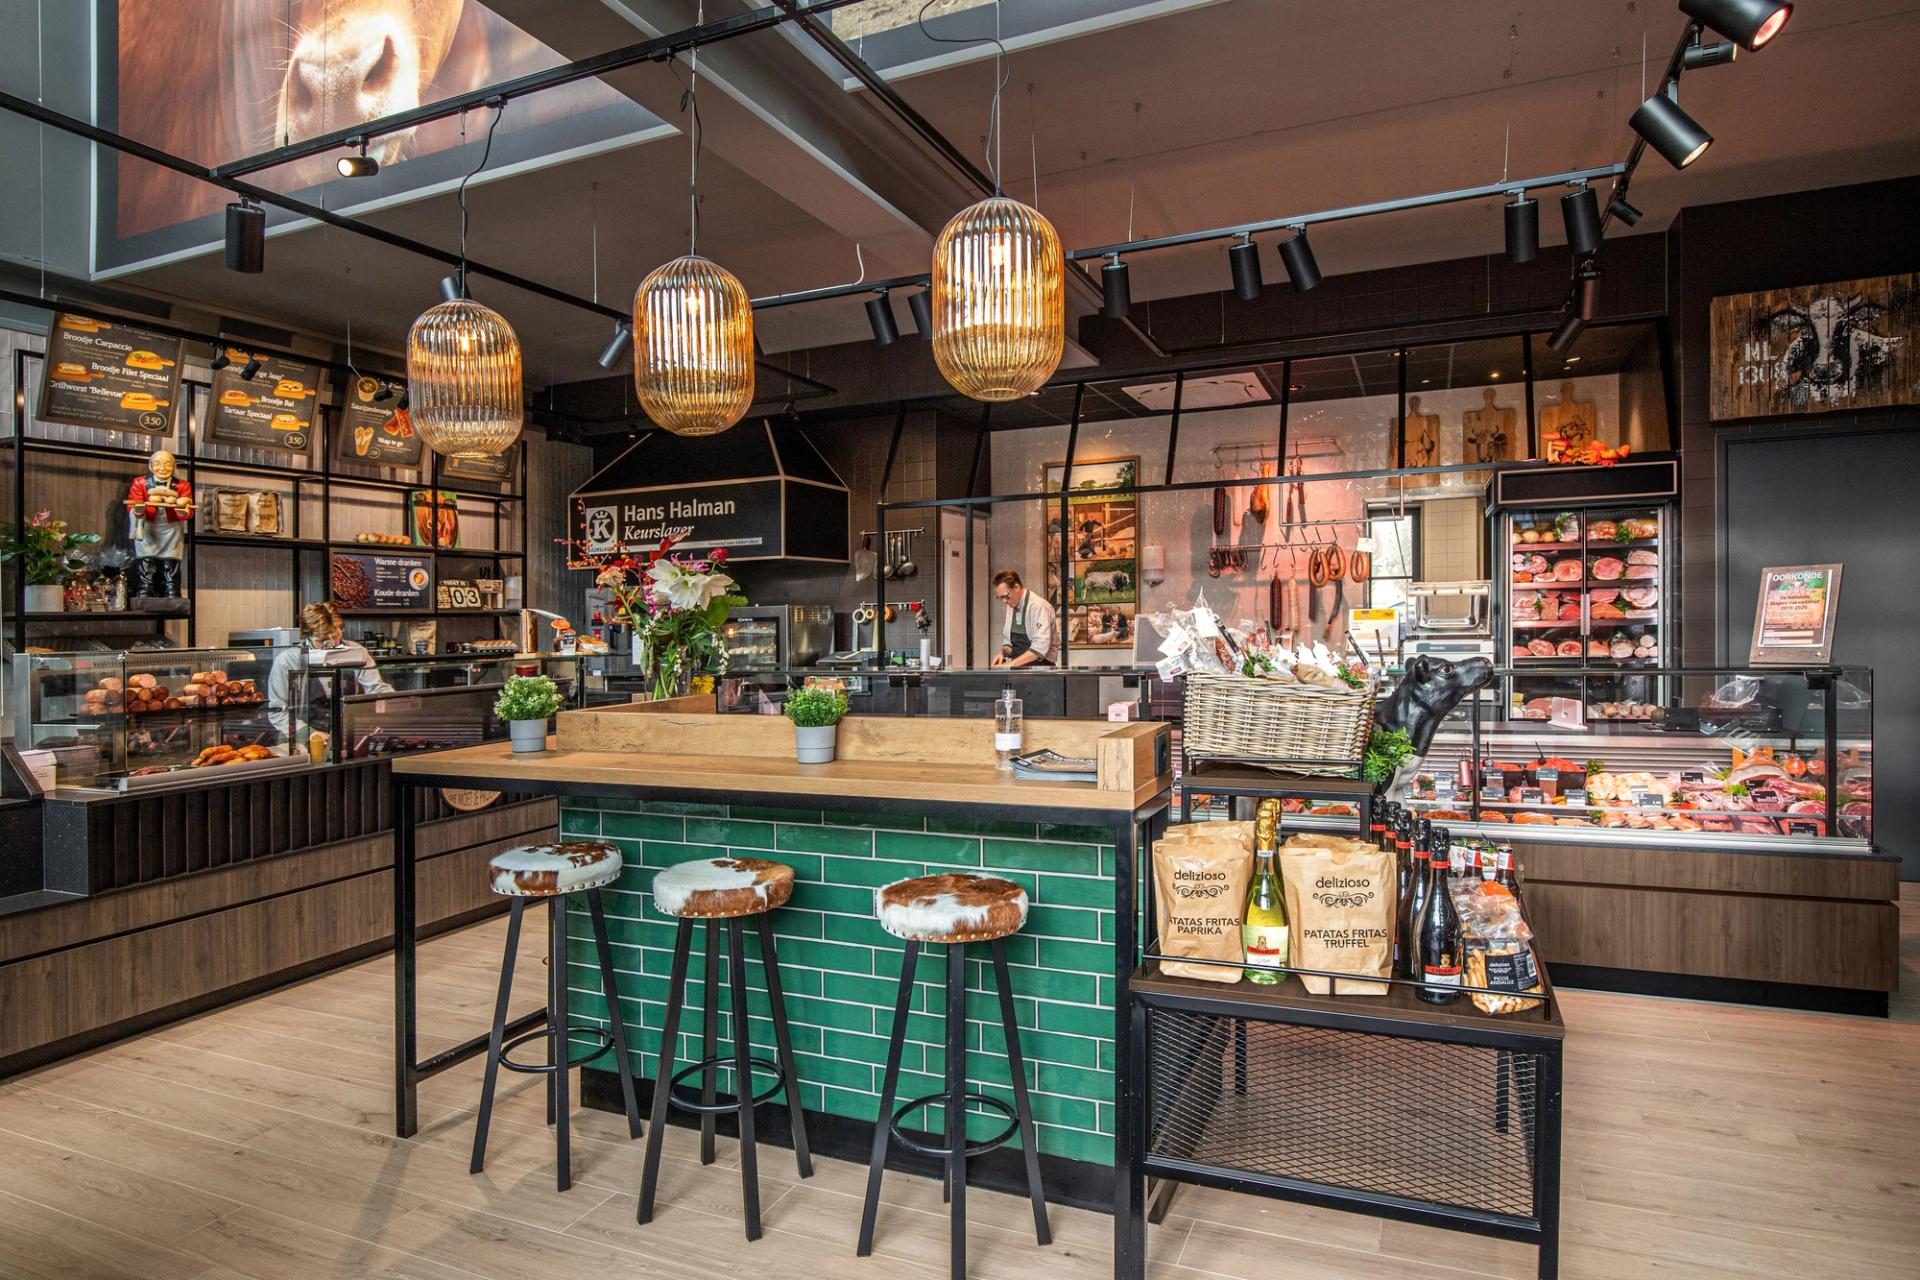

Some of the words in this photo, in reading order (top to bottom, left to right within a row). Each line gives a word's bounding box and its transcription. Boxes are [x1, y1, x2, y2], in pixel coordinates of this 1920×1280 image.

[63, 332, 93, 345] Broodje
[95, 338, 133, 352] Carpaccio
[1745, 341, 1778, 362] NL
[91, 362, 121, 375] Broodje
[122, 367, 138, 377] Filet
[139, 371, 169, 382] Speciaal
[261, 396, 284, 406] Broodje
[224, 406, 246, 415] Tartaar
[247, 410, 273, 420] Speciaal
[624, 505, 665, 521] Hans
[670, 499, 735, 518] Halman
[624, 522, 695, 540] Keurslager
[374, 557, 396, 566] Warme
[398, 559, 422, 567] dranken
[1772, 571, 1823, 582] OORKONDE
[374, 589, 394, 597] Koude
[1174, 869, 1226, 881] delizioso
[1316, 876, 1370, 888] delizioso
[1205, 917, 1240, 927] FRITAS
[1177, 926, 1222, 935] PAPRIKA
[1304, 929, 1350, 938] PATATAS
[1352, 929, 1387, 938] FRITAS
[1324, 939, 1369, 948] TRUFFEL
